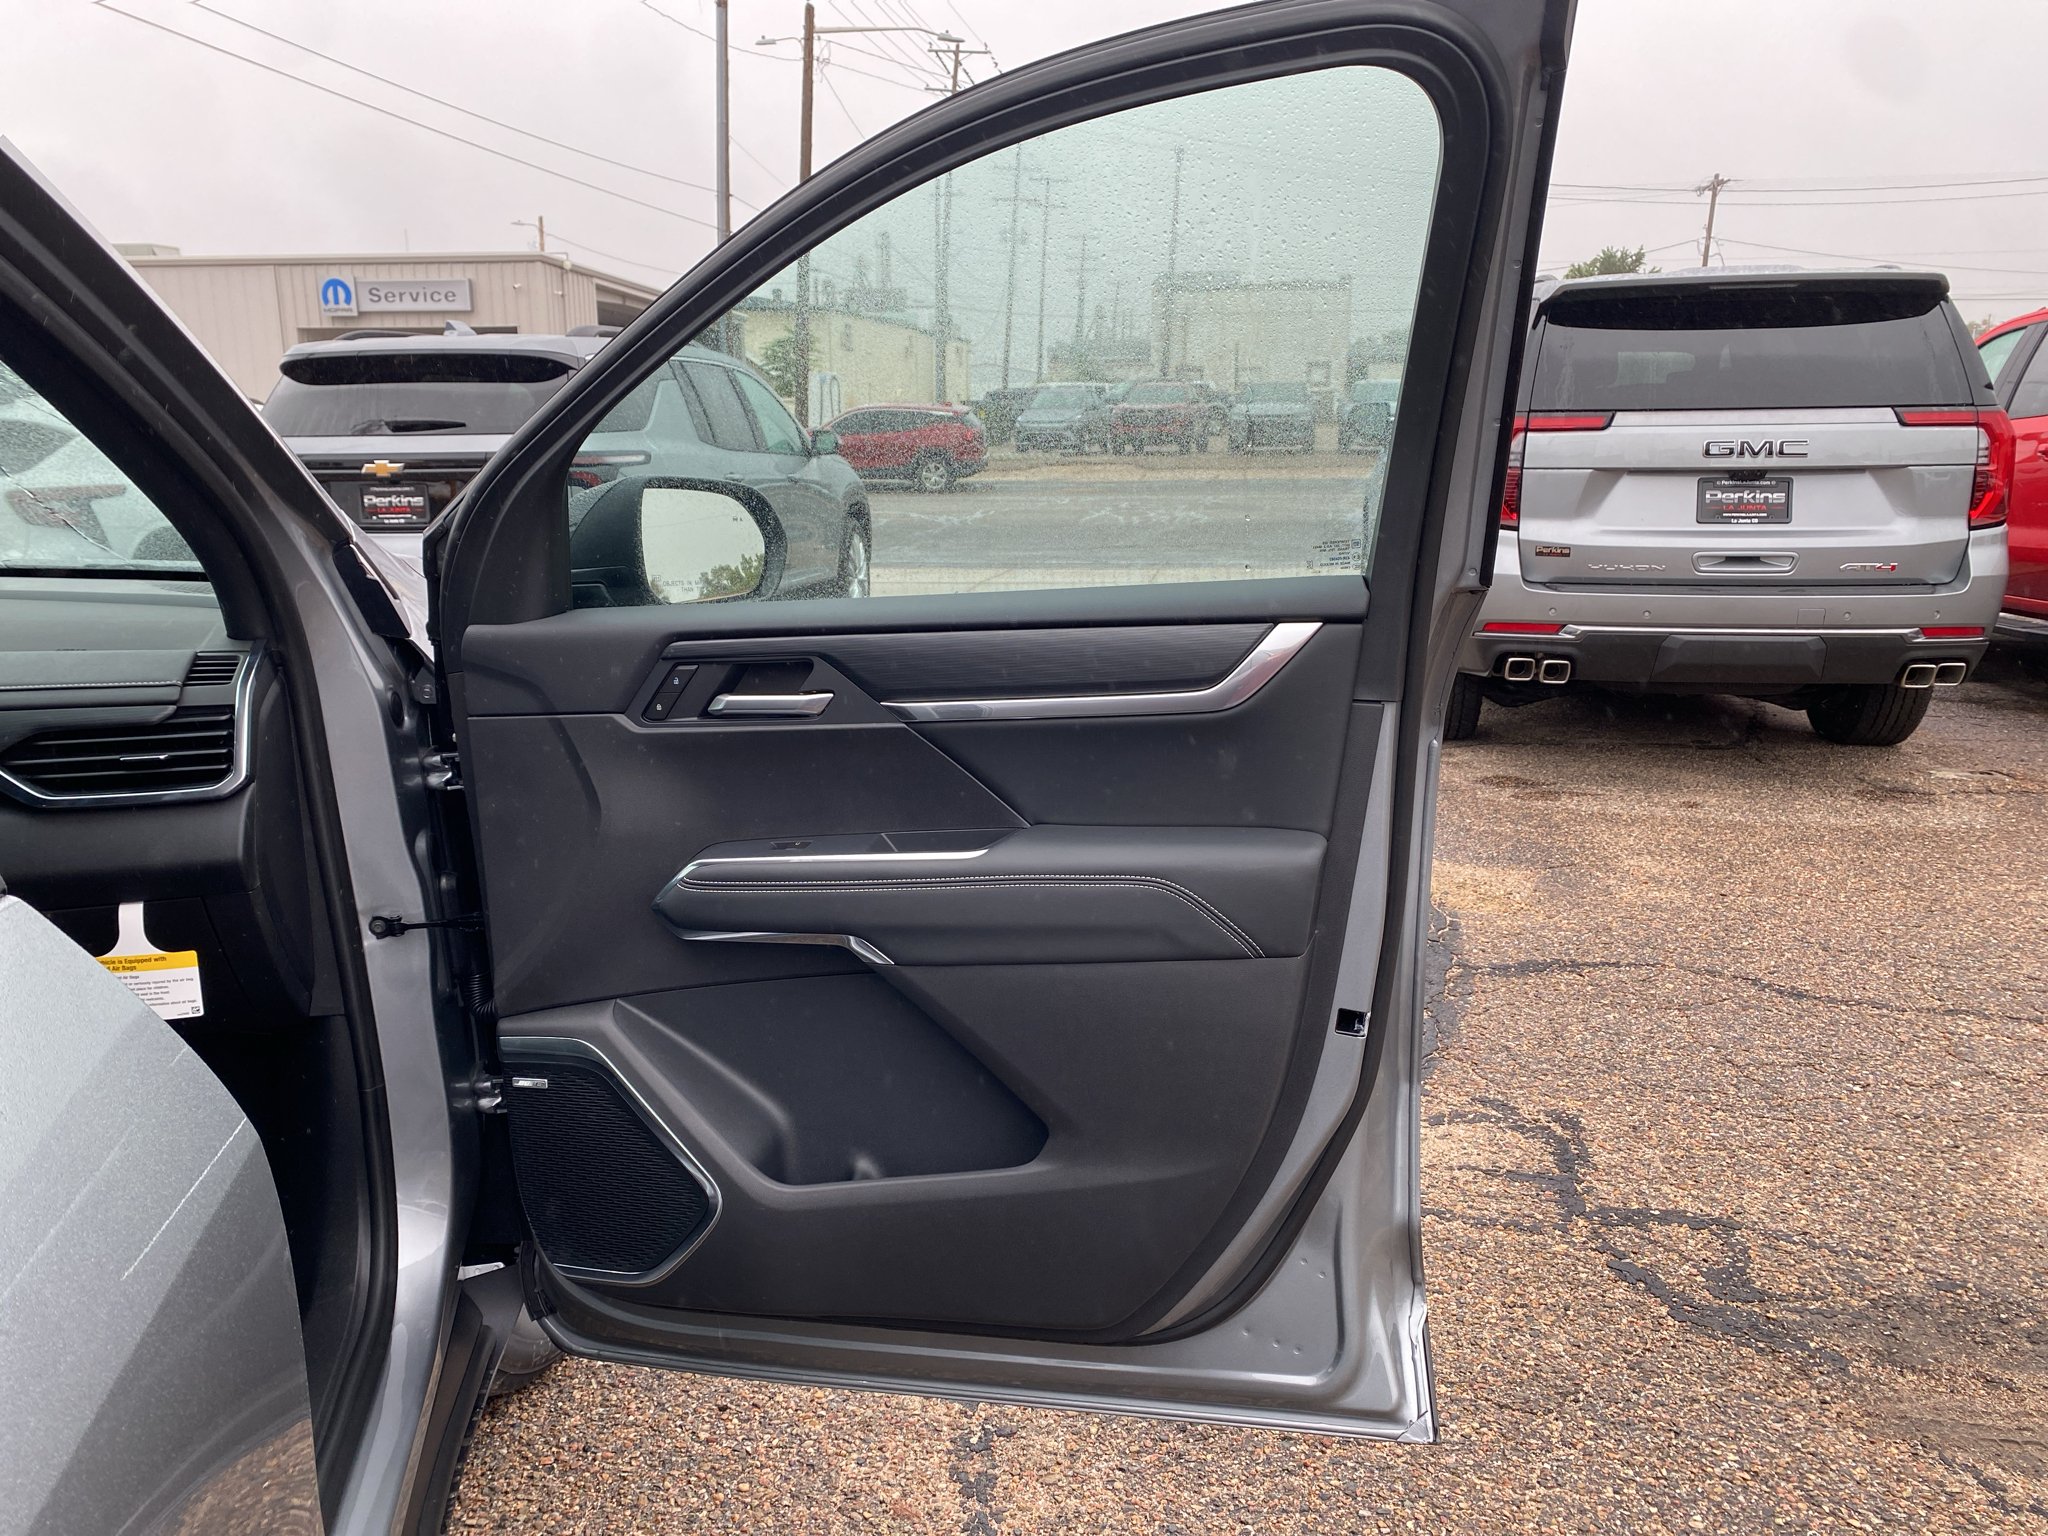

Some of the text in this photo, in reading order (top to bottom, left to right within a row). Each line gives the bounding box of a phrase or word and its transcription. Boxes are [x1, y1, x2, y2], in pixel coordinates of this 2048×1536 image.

[368, 286, 457, 303] Service
[1702, 439, 1809, 458] GMC
[363, 495, 424, 507] Perkins
[1705, 490, 1786, 504] Perkins
[1536, 546, 1570, 554] Perkins
[1587, 563, 1667, 572] YUKON
[1840, 562, 1898, 572] AT4
[124, 957, 152, 965] Equipped
